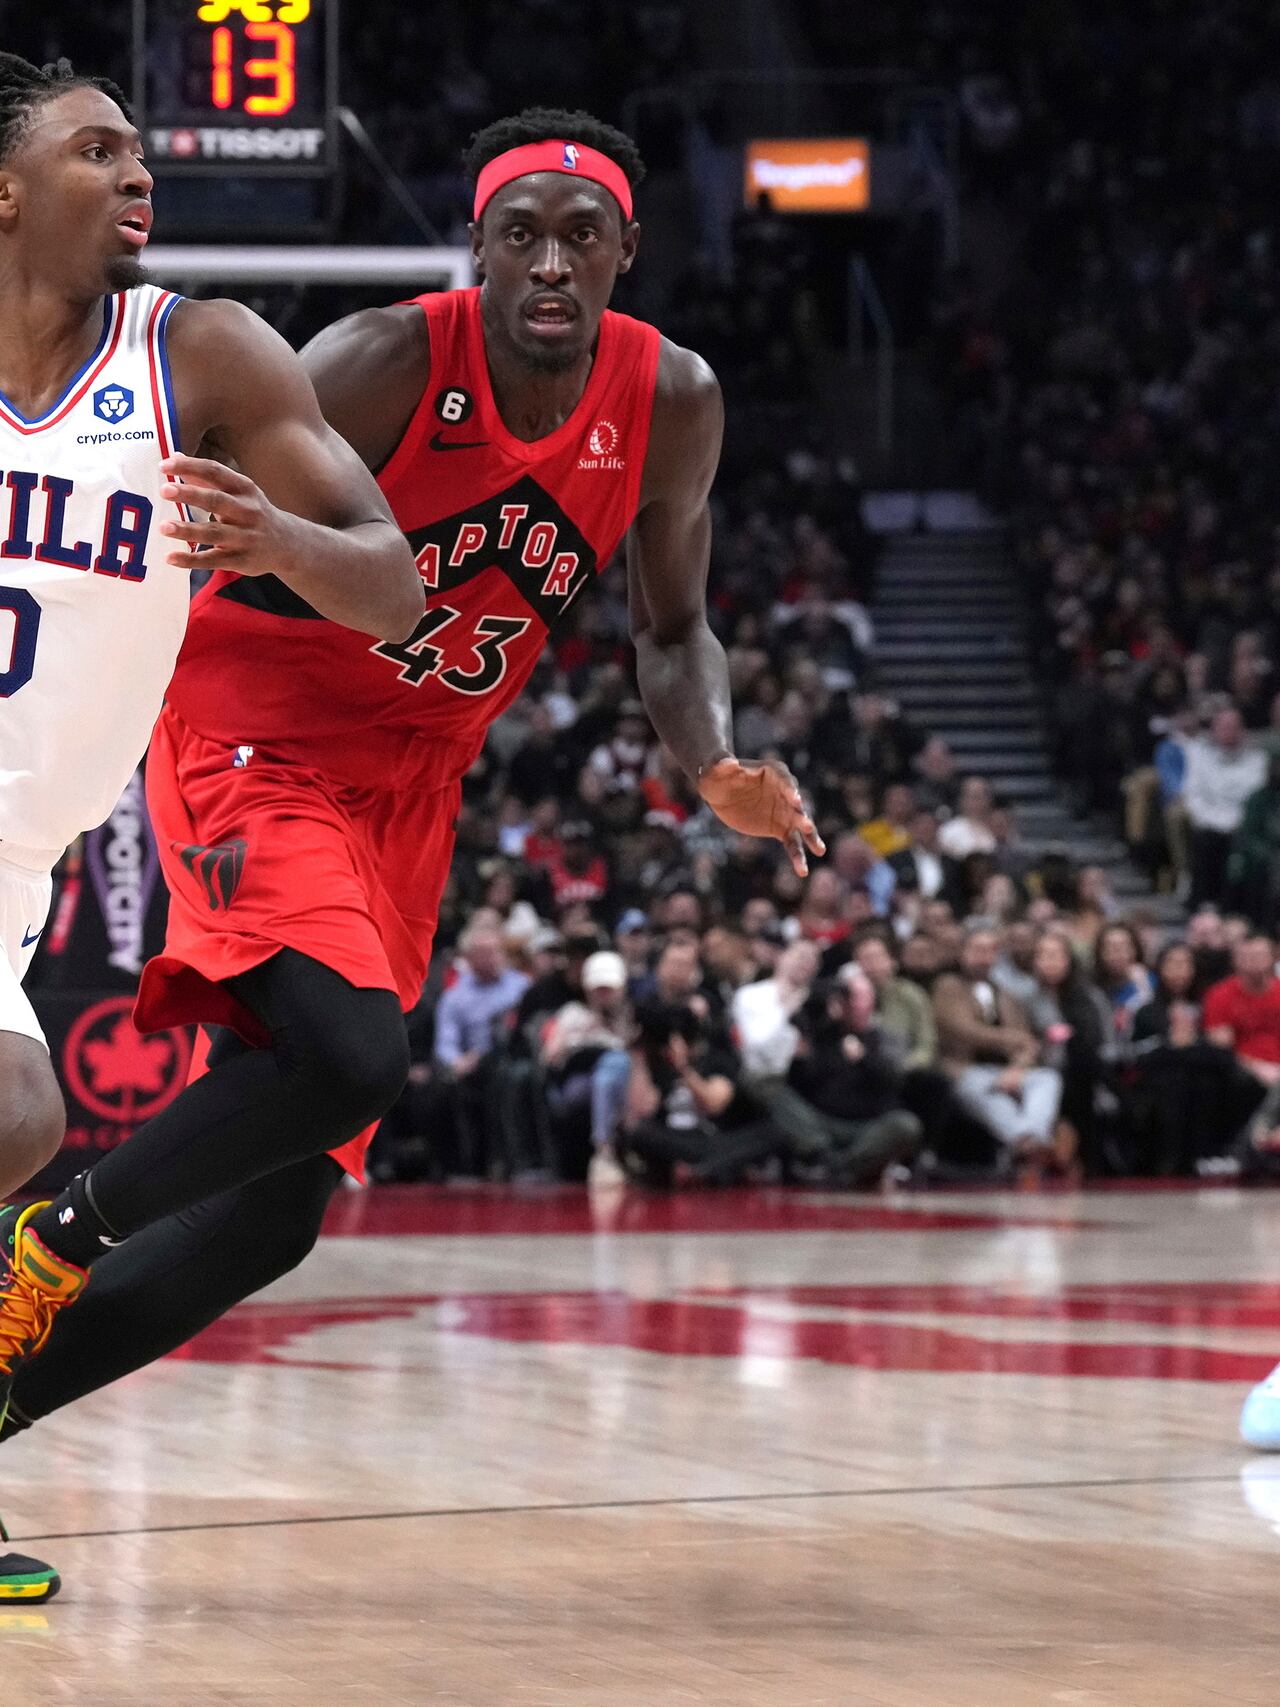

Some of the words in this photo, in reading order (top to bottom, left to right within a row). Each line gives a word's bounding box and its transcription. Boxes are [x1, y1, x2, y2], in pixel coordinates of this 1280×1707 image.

[212, 22, 296, 116] 13
[201, 129, 322, 157] TISSOT
[441, 391, 466, 421] 6
[76, 429, 155, 445] crypto.com
[577, 457, 598, 470] Sun
[600, 457, 626, 470] Life
[414, 504, 588, 616] APTOR
[369, 604, 532, 696] 43
